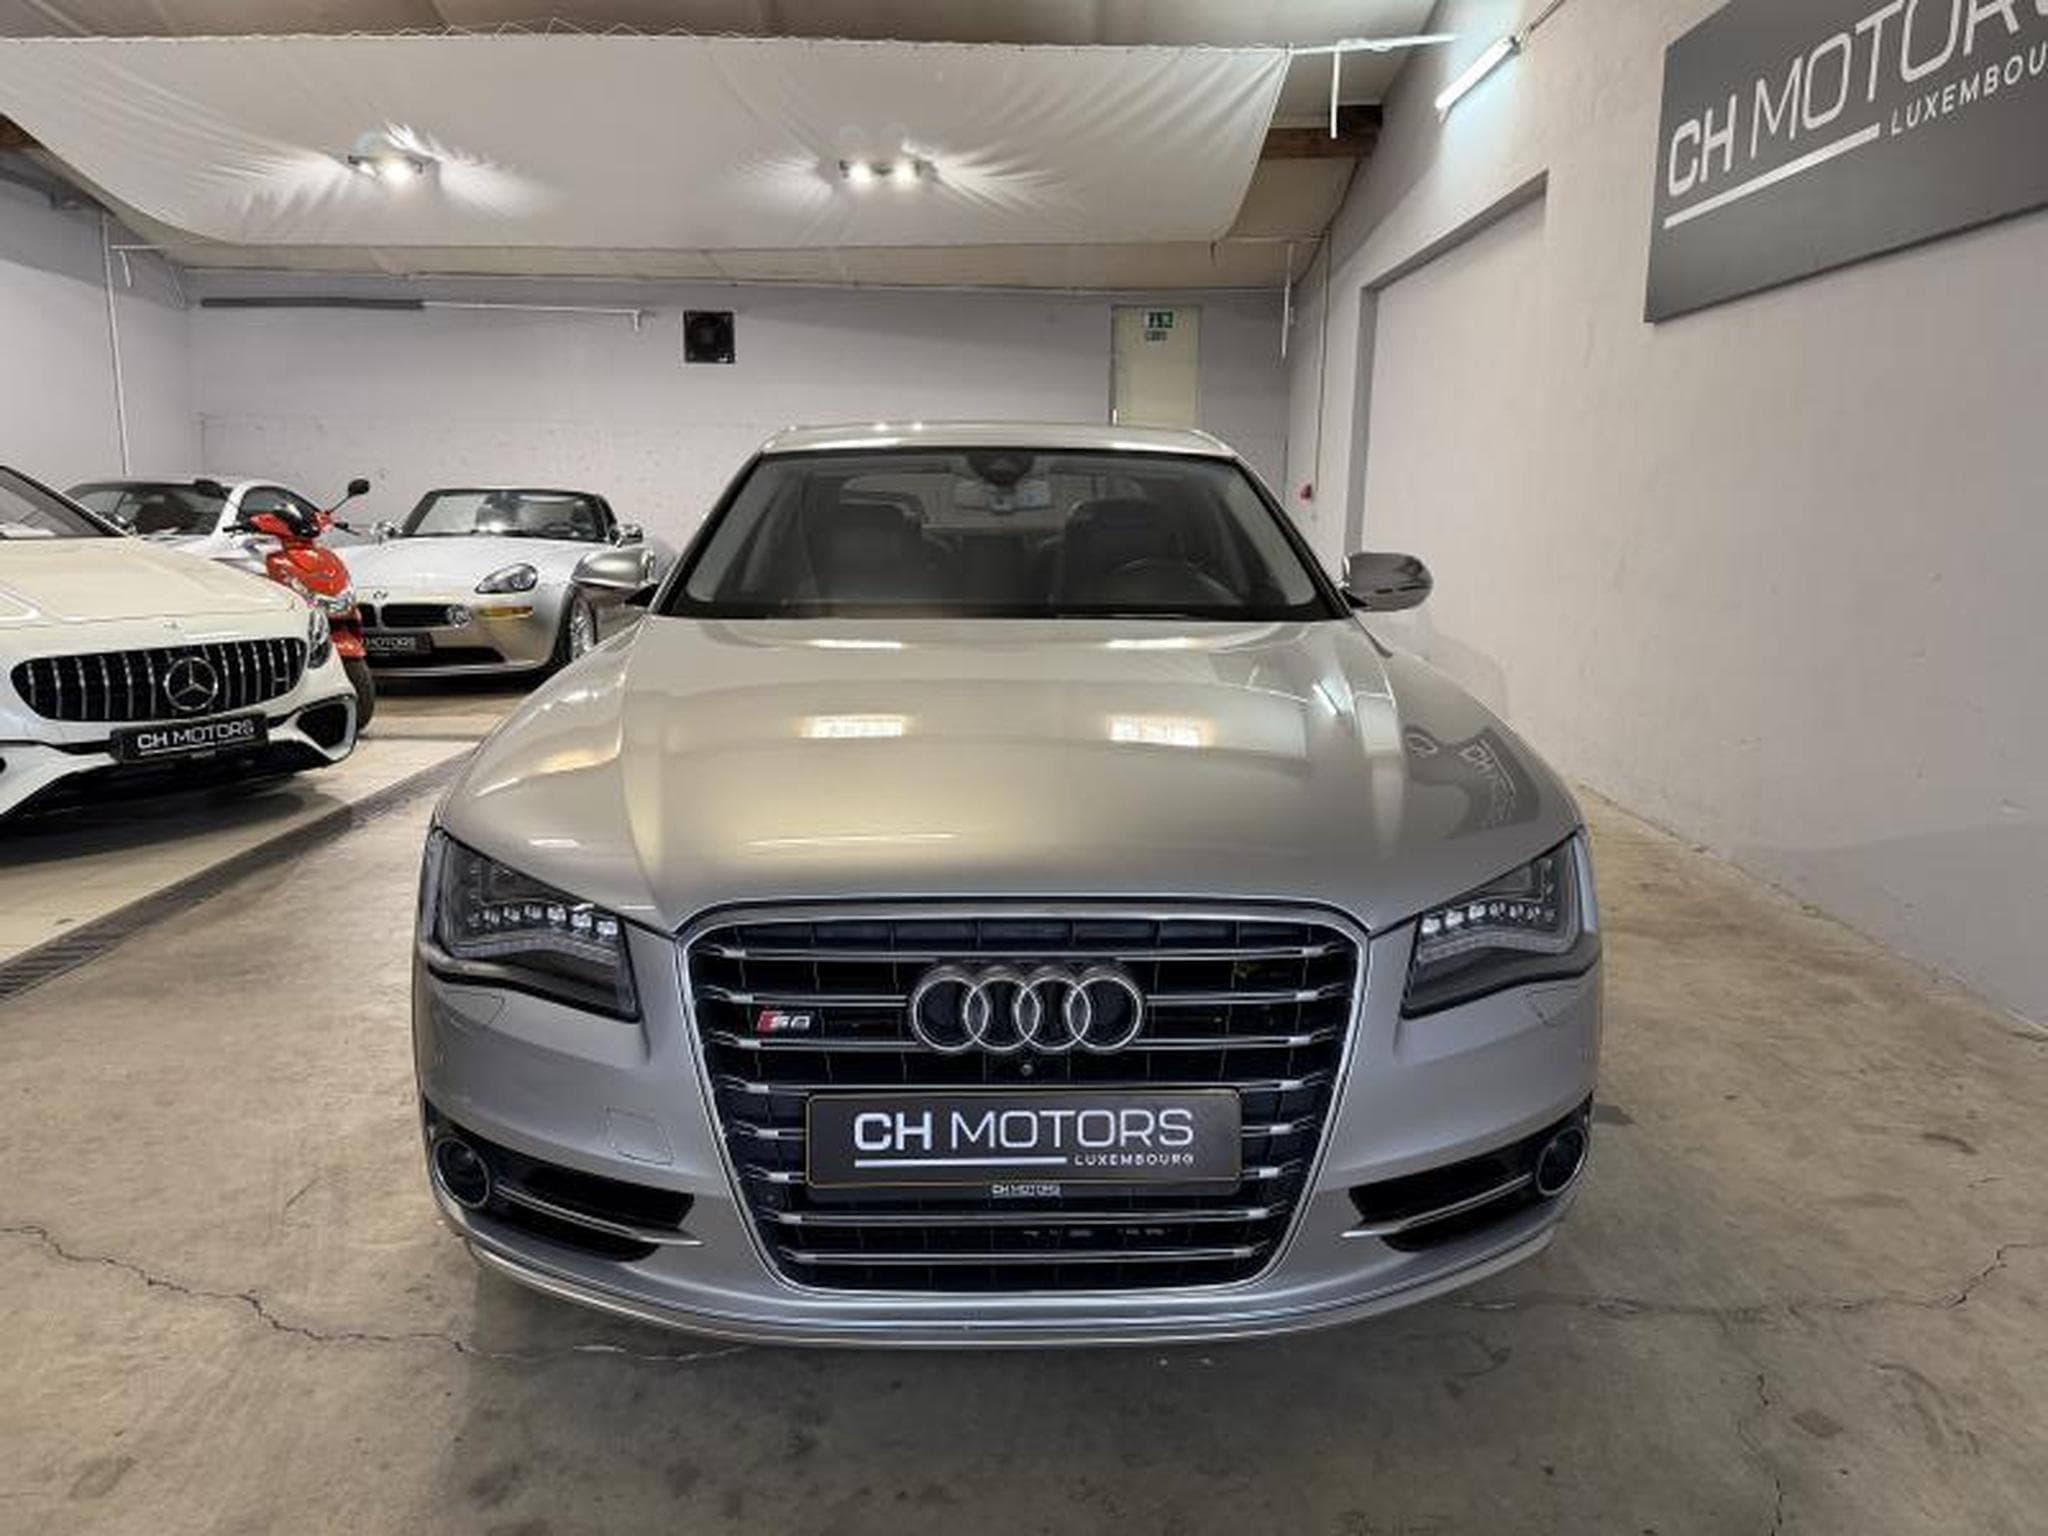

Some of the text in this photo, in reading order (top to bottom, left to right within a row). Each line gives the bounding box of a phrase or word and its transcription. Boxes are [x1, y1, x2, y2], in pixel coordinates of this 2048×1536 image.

[1668, 0, 2048, 197] CH MOTOR
[137, 732, 168, 749] CH
[173, 719, 255, 744] MOTORS
[854, 1109, 1194, 1150] CH MOTORS
[1074, 1153, 1195, 1167] LUXEMBOURG
[992, 1184, 1009, 1197] CH
